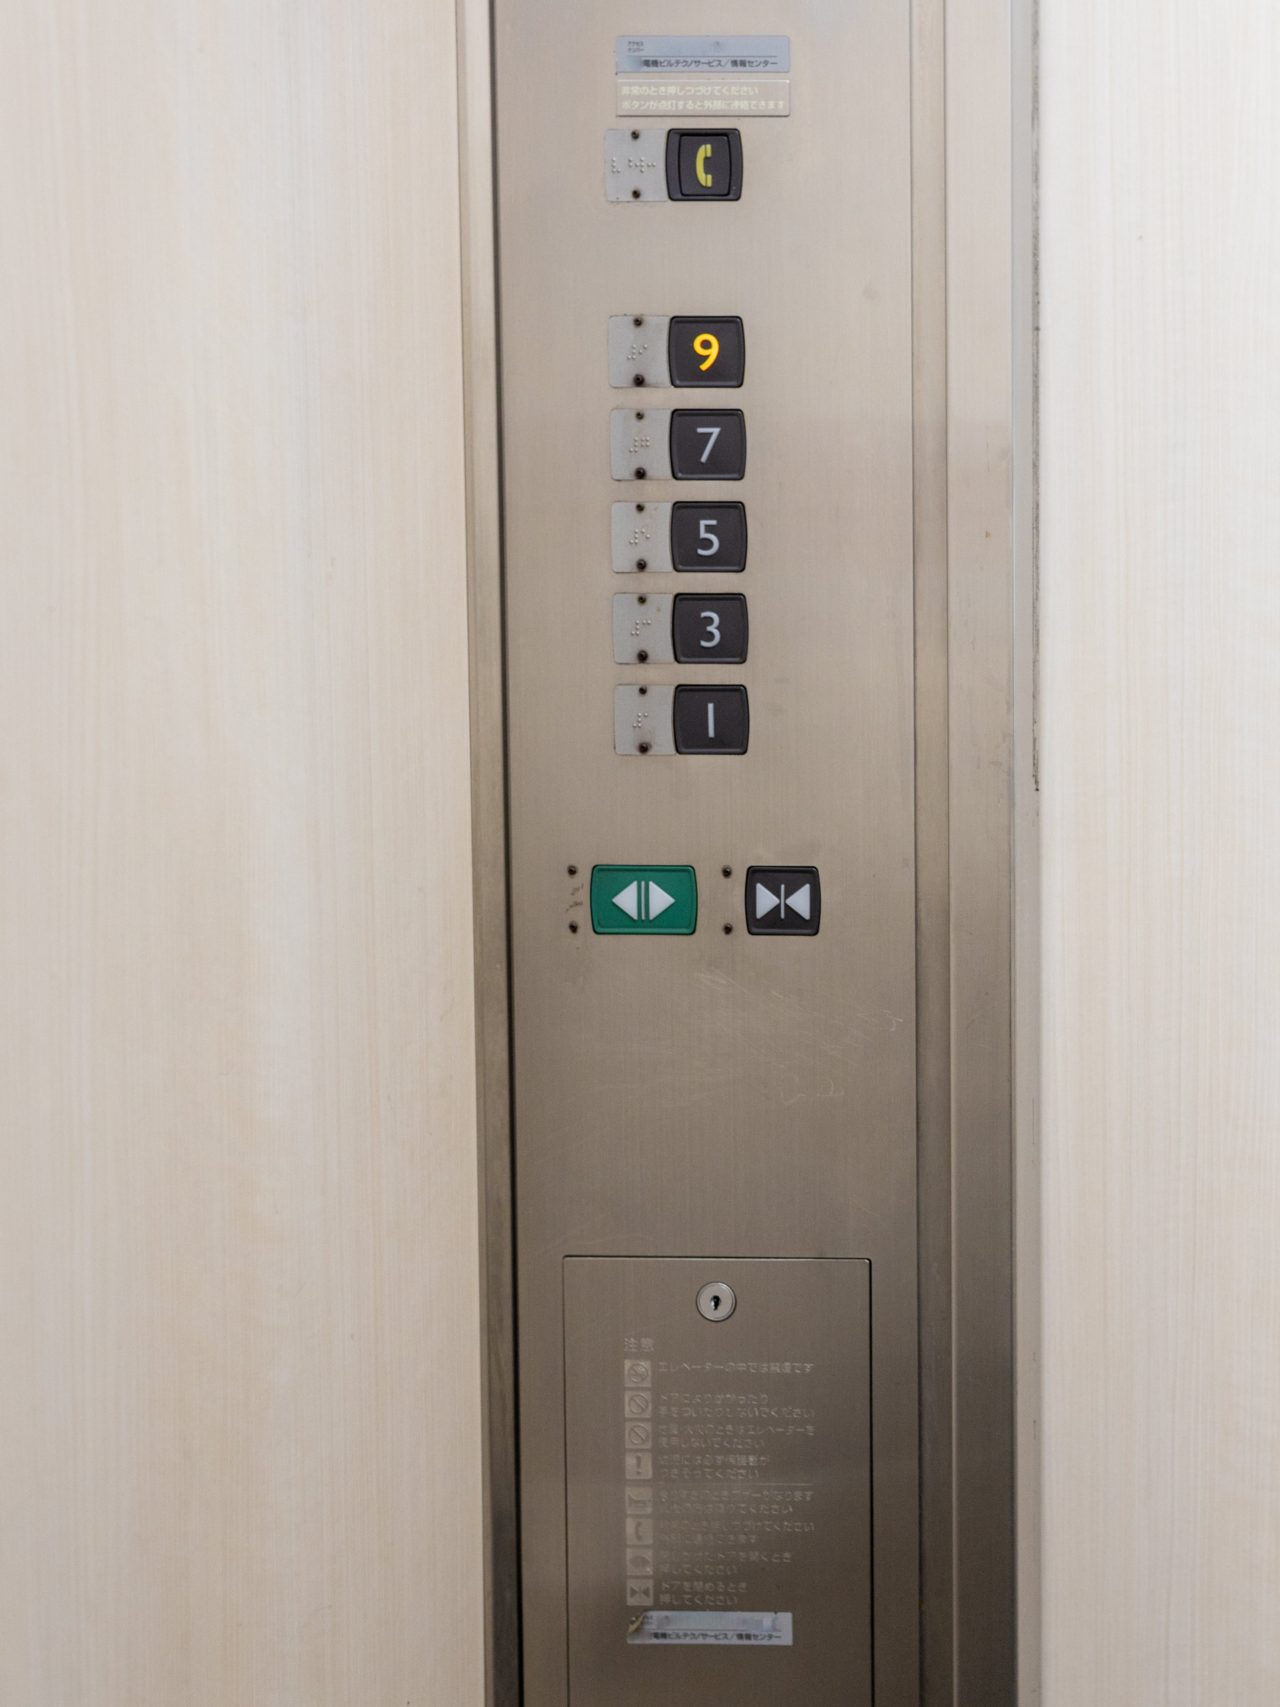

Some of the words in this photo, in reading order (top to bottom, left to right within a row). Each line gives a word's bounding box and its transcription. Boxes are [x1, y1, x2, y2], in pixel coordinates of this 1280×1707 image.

[693, 333, 720, 372] 9
[696, 427, 721, 464] 7
[696, 519, 720, 556] 5
[699, 611, 721, 648] 3
